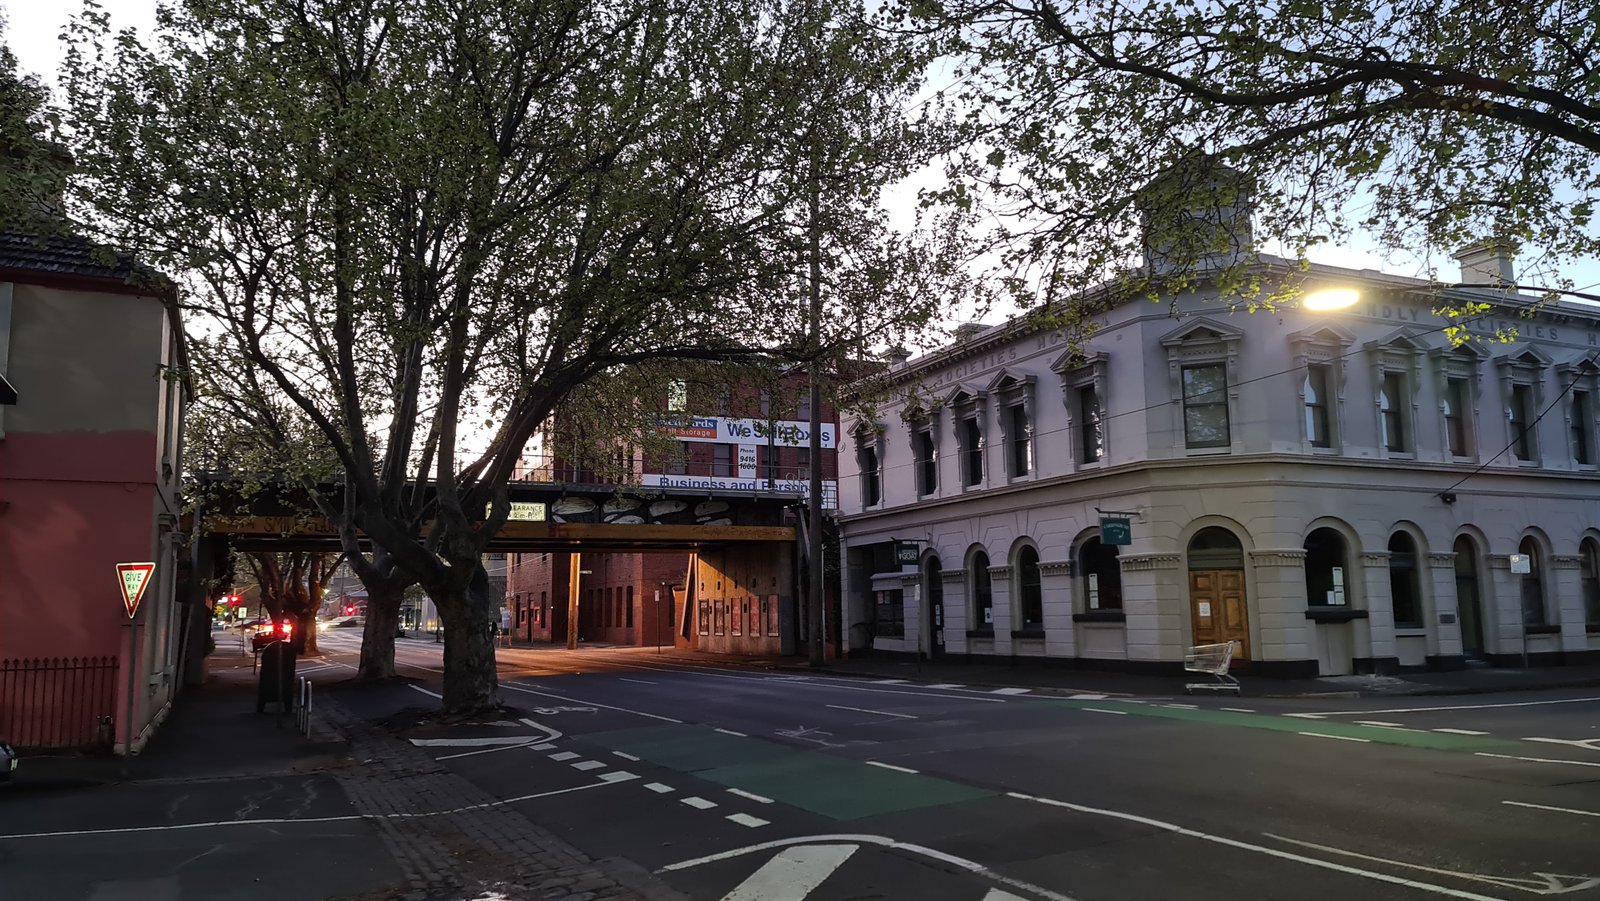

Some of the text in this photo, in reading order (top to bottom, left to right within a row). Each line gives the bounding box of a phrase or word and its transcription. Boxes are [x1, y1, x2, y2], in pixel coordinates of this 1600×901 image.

[727, 423, 830, 442] We Sll Boxs
[660, 477, 726, 489] Business
[731, 481, 756, 491] and
[125, 573, 142, 582] GIVE
